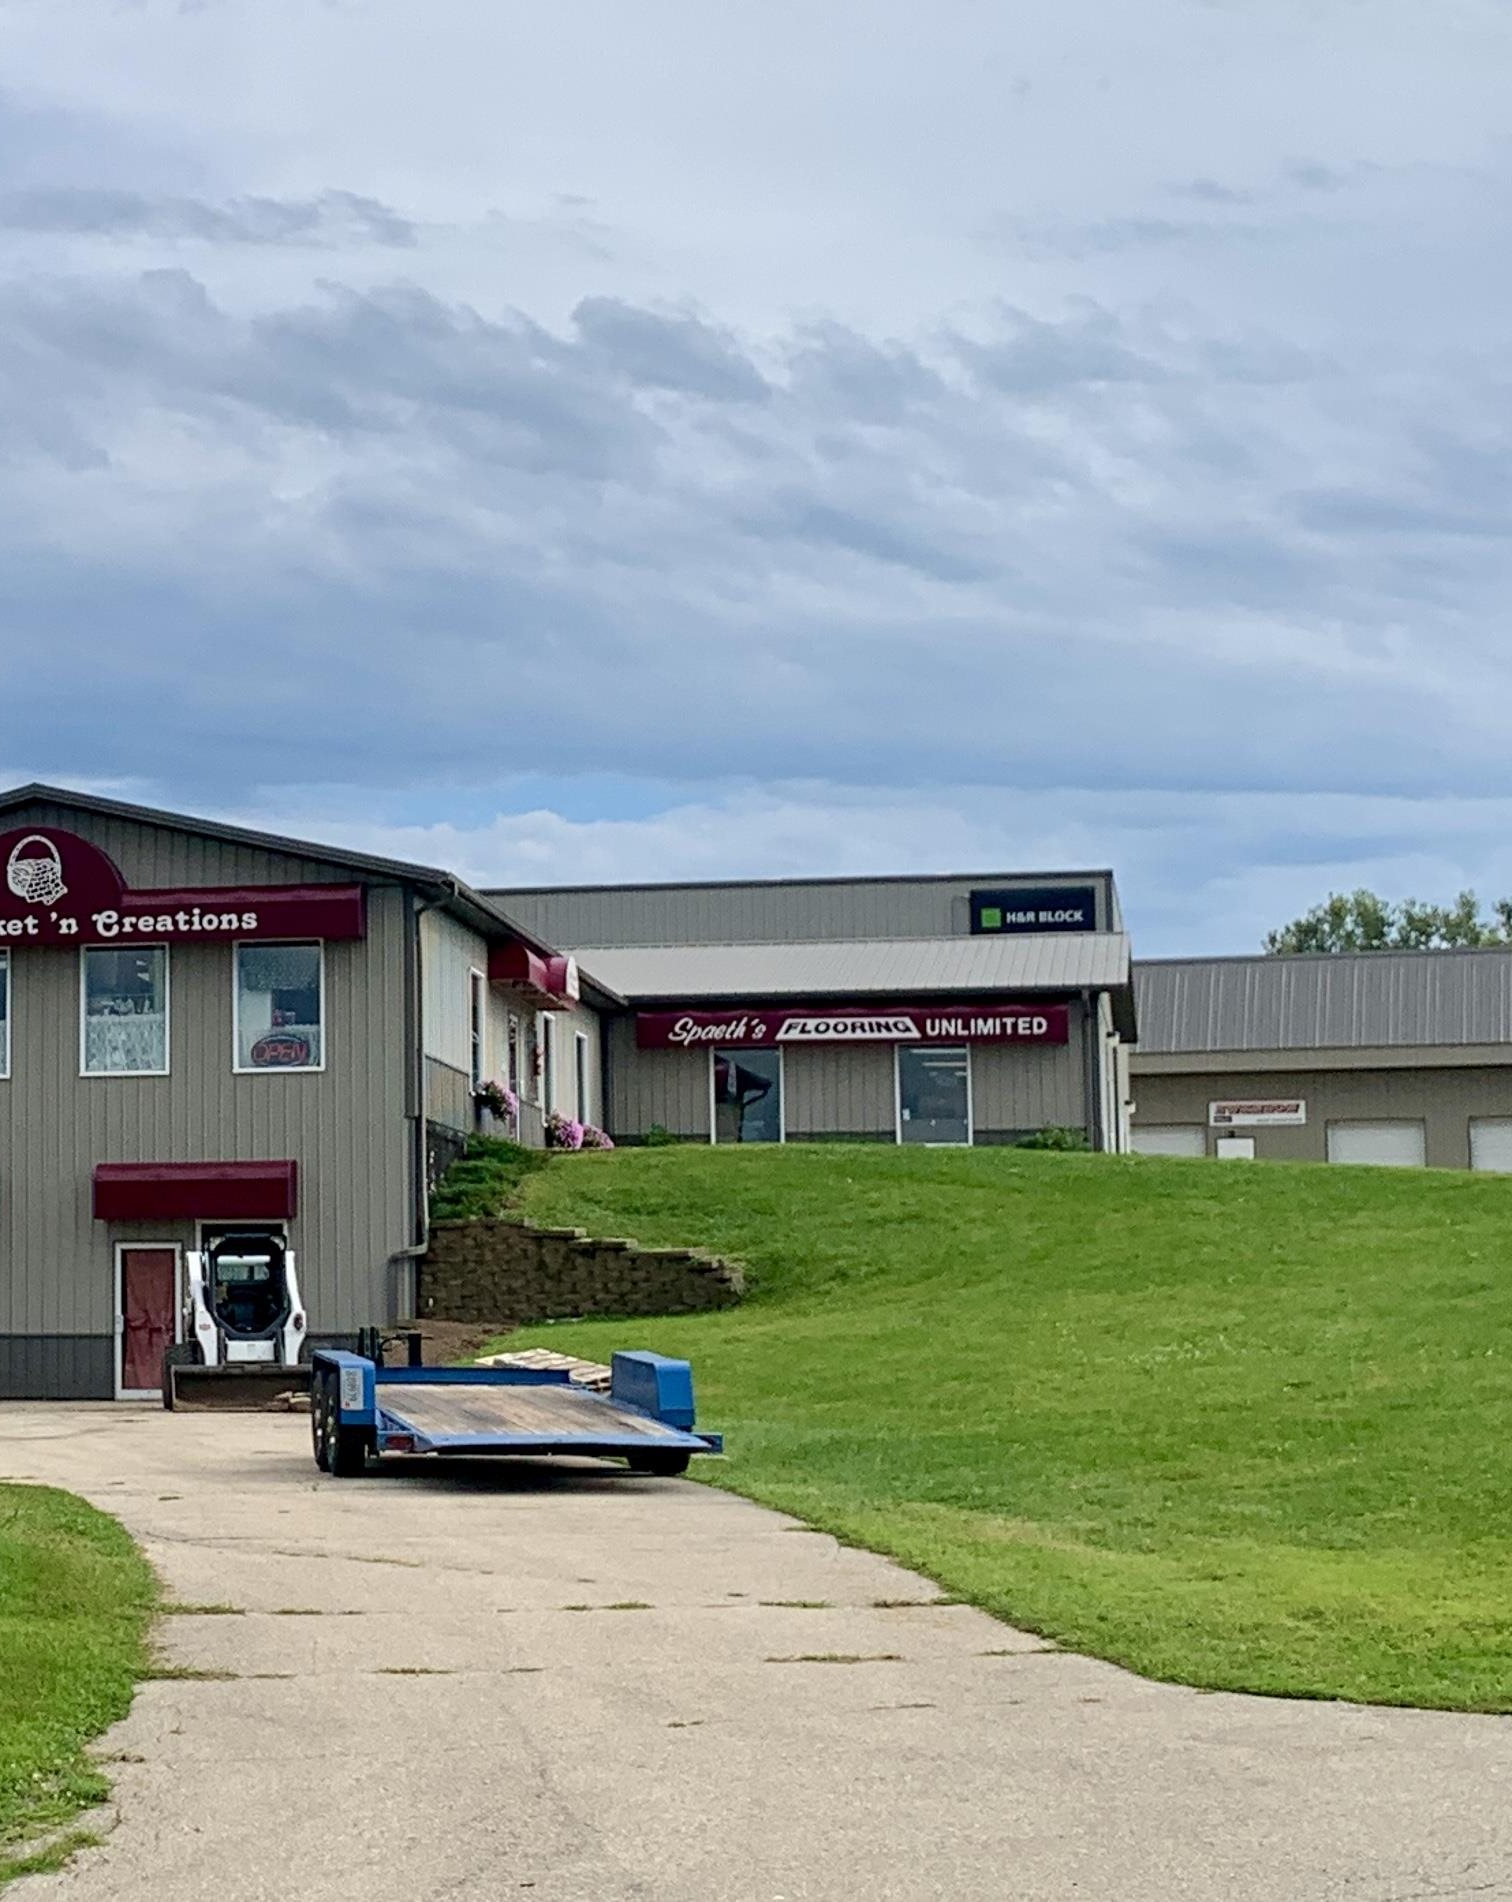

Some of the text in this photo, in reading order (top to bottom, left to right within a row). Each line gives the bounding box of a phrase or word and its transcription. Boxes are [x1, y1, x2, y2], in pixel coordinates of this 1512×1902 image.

[50, 911, 78, 935] 'n
[92, 908, 258, 938] Creations
[1006, 908, 1084, 924] H&R BLOCK
[668, 1016, 1049, 1046] Spaeth's FLOORING UNLIMITED
